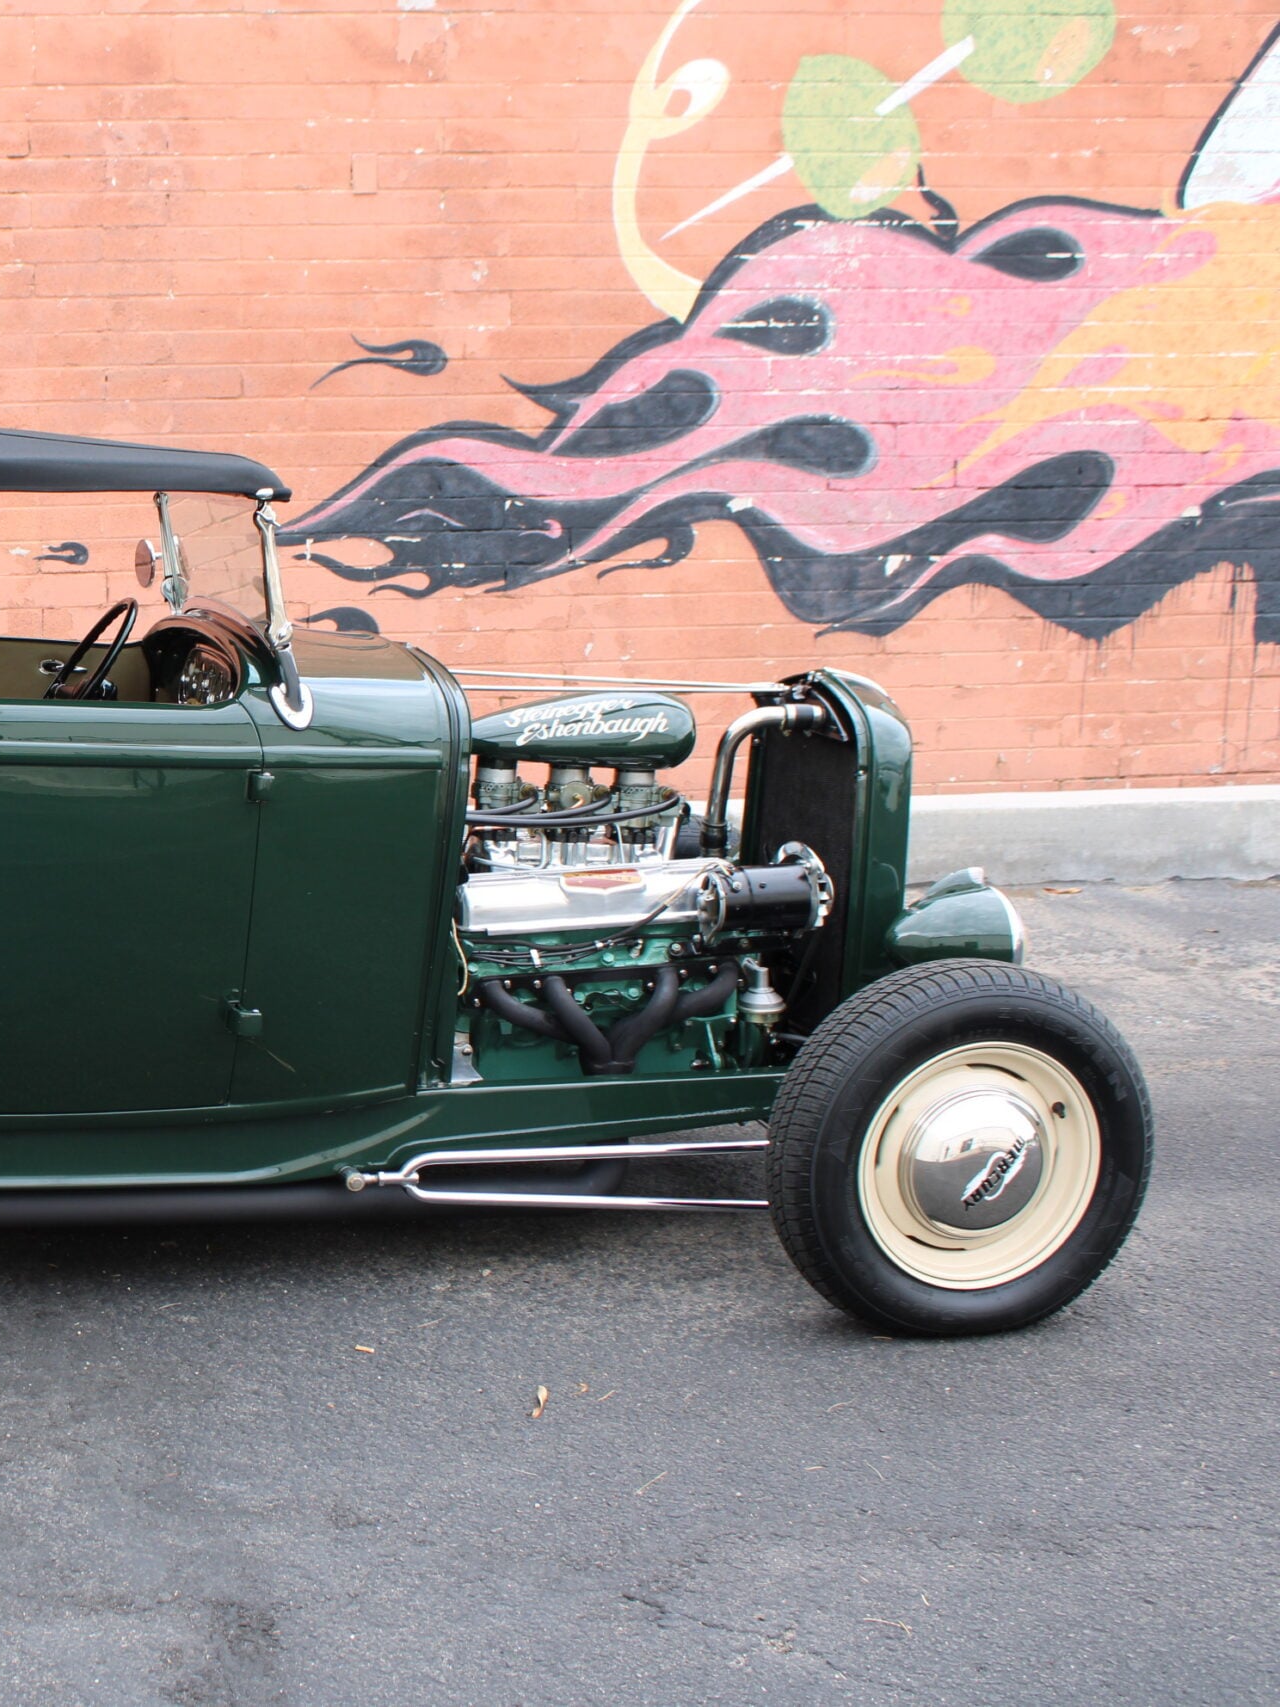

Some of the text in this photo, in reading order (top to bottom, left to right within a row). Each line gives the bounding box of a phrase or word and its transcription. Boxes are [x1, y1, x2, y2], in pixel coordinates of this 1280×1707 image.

[504, 699, 638, 728] Steinegger
[516, 712, 669, 746] Eshenbaugh
[963, 1136, 1026, 1211] MERCURY
